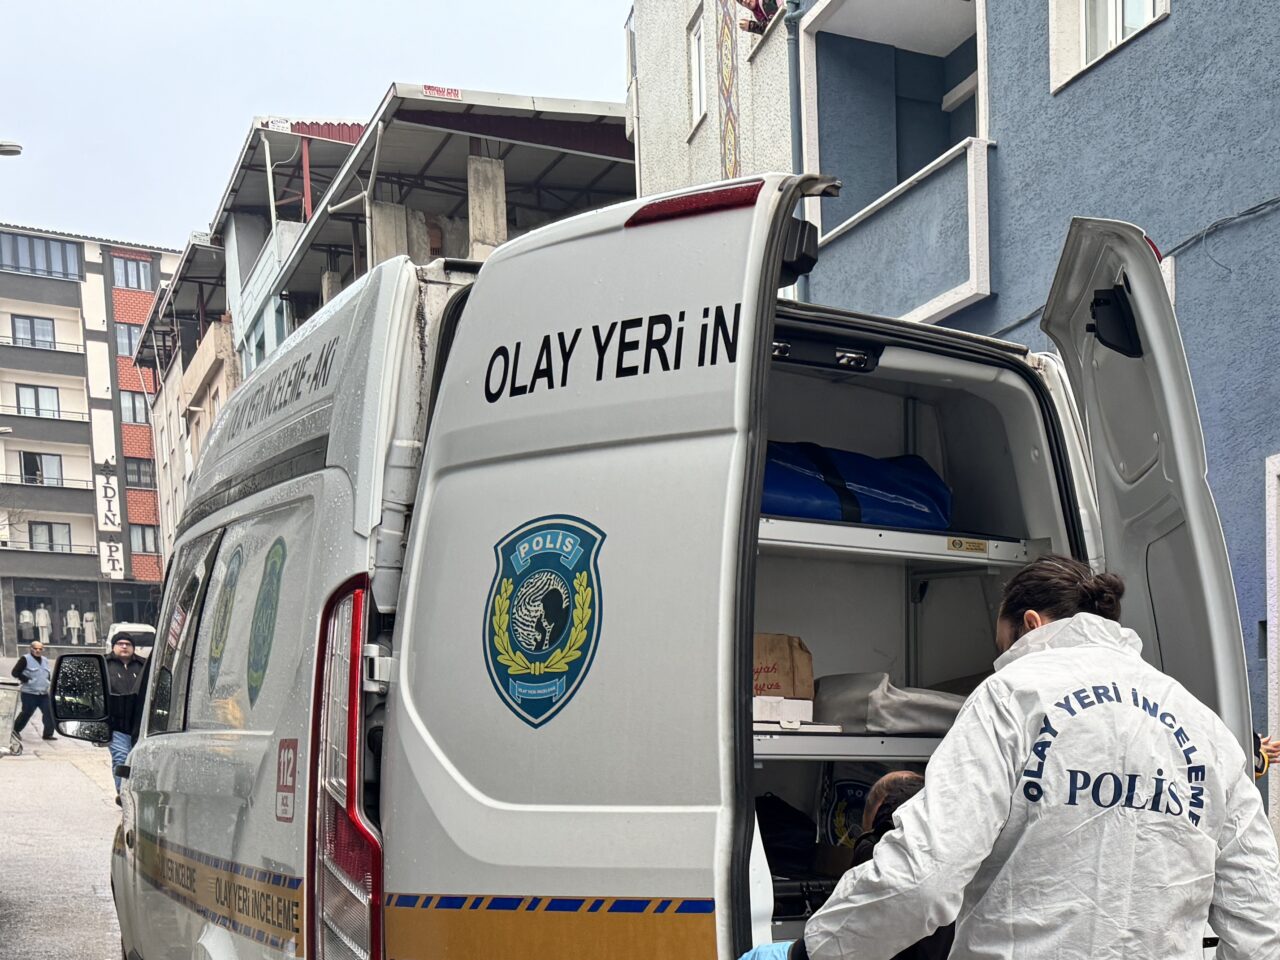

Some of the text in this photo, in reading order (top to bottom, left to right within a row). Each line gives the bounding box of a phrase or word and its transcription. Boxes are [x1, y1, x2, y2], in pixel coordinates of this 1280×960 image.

[484, 328, 582, 403] OLAY
[519, 532, 574, 558] POLİS
[280, 748, 294, 786] 112
[1023, 682, 1205, 827] OLAY YERİ İNCELEME
[1064, 768, 1183, 816] POLİS
[215, 876, 232, 909] OLAY
